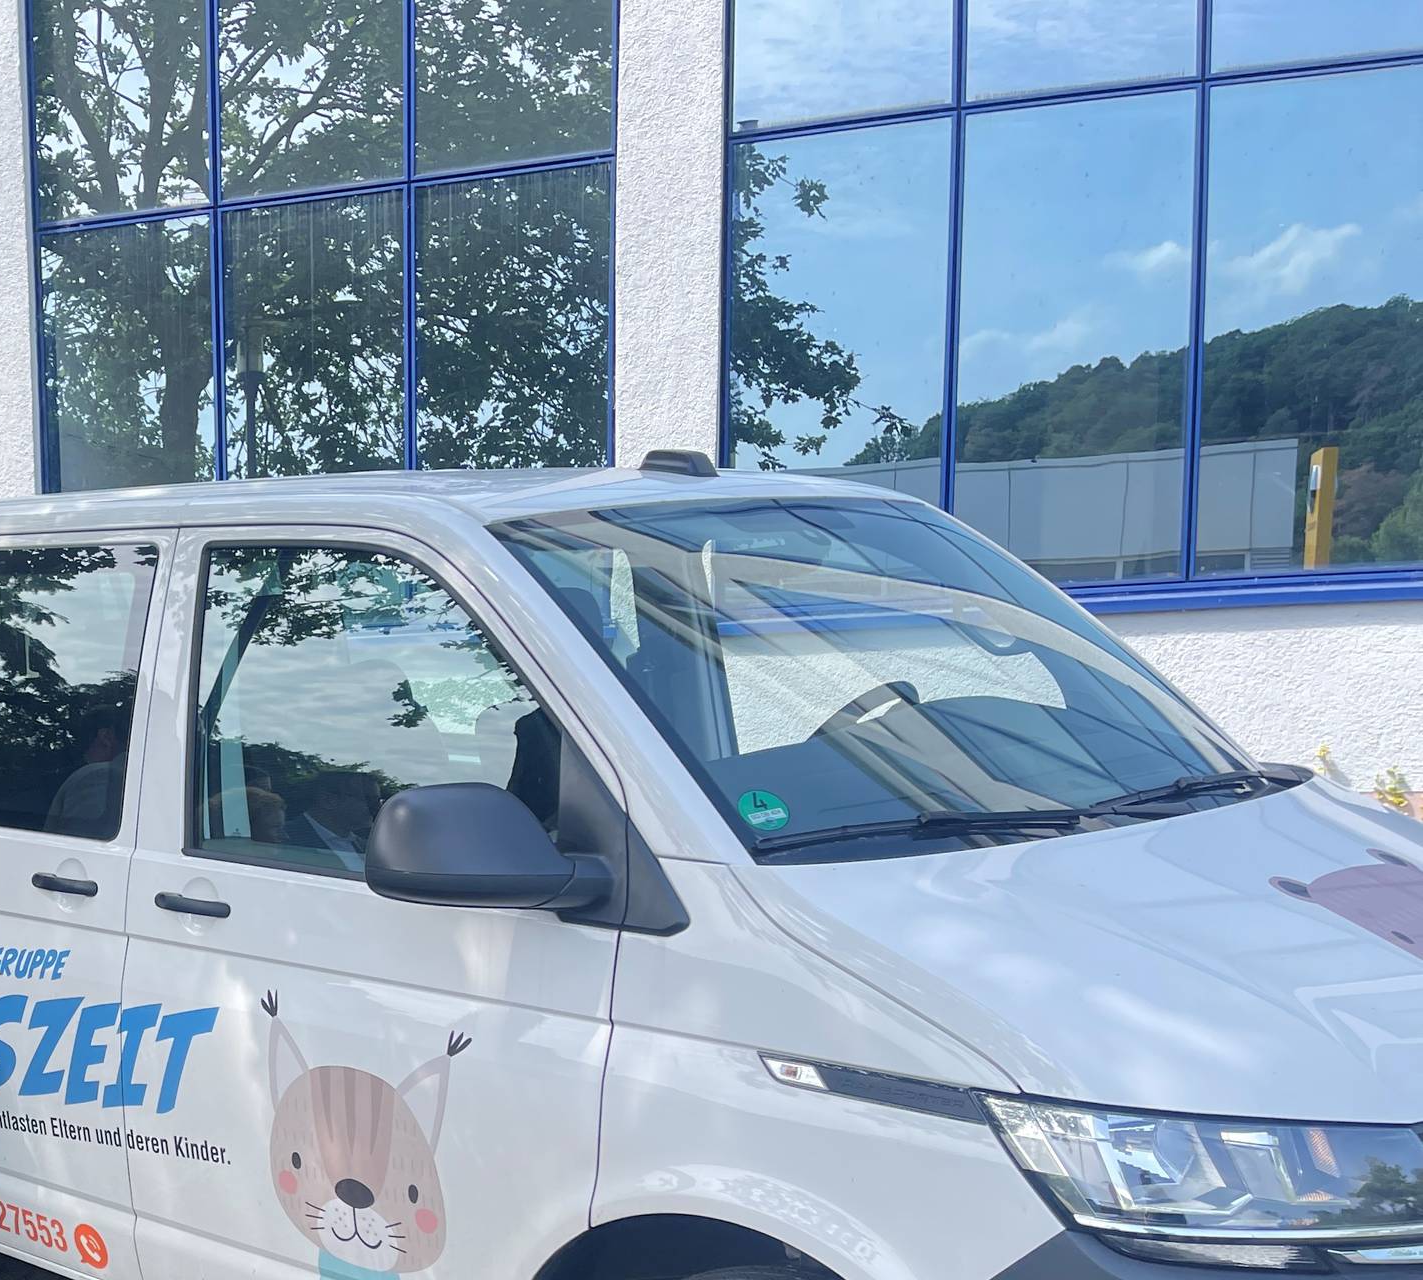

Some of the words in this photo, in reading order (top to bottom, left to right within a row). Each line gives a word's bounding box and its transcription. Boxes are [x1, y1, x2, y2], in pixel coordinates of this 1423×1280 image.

[50, 1117, 92, 1143] Eltern
[95, 1126, 122, 1148] und
[127, 1129, 170, 1155] deren
[174, 1135, 231, 1165] Kinder.
